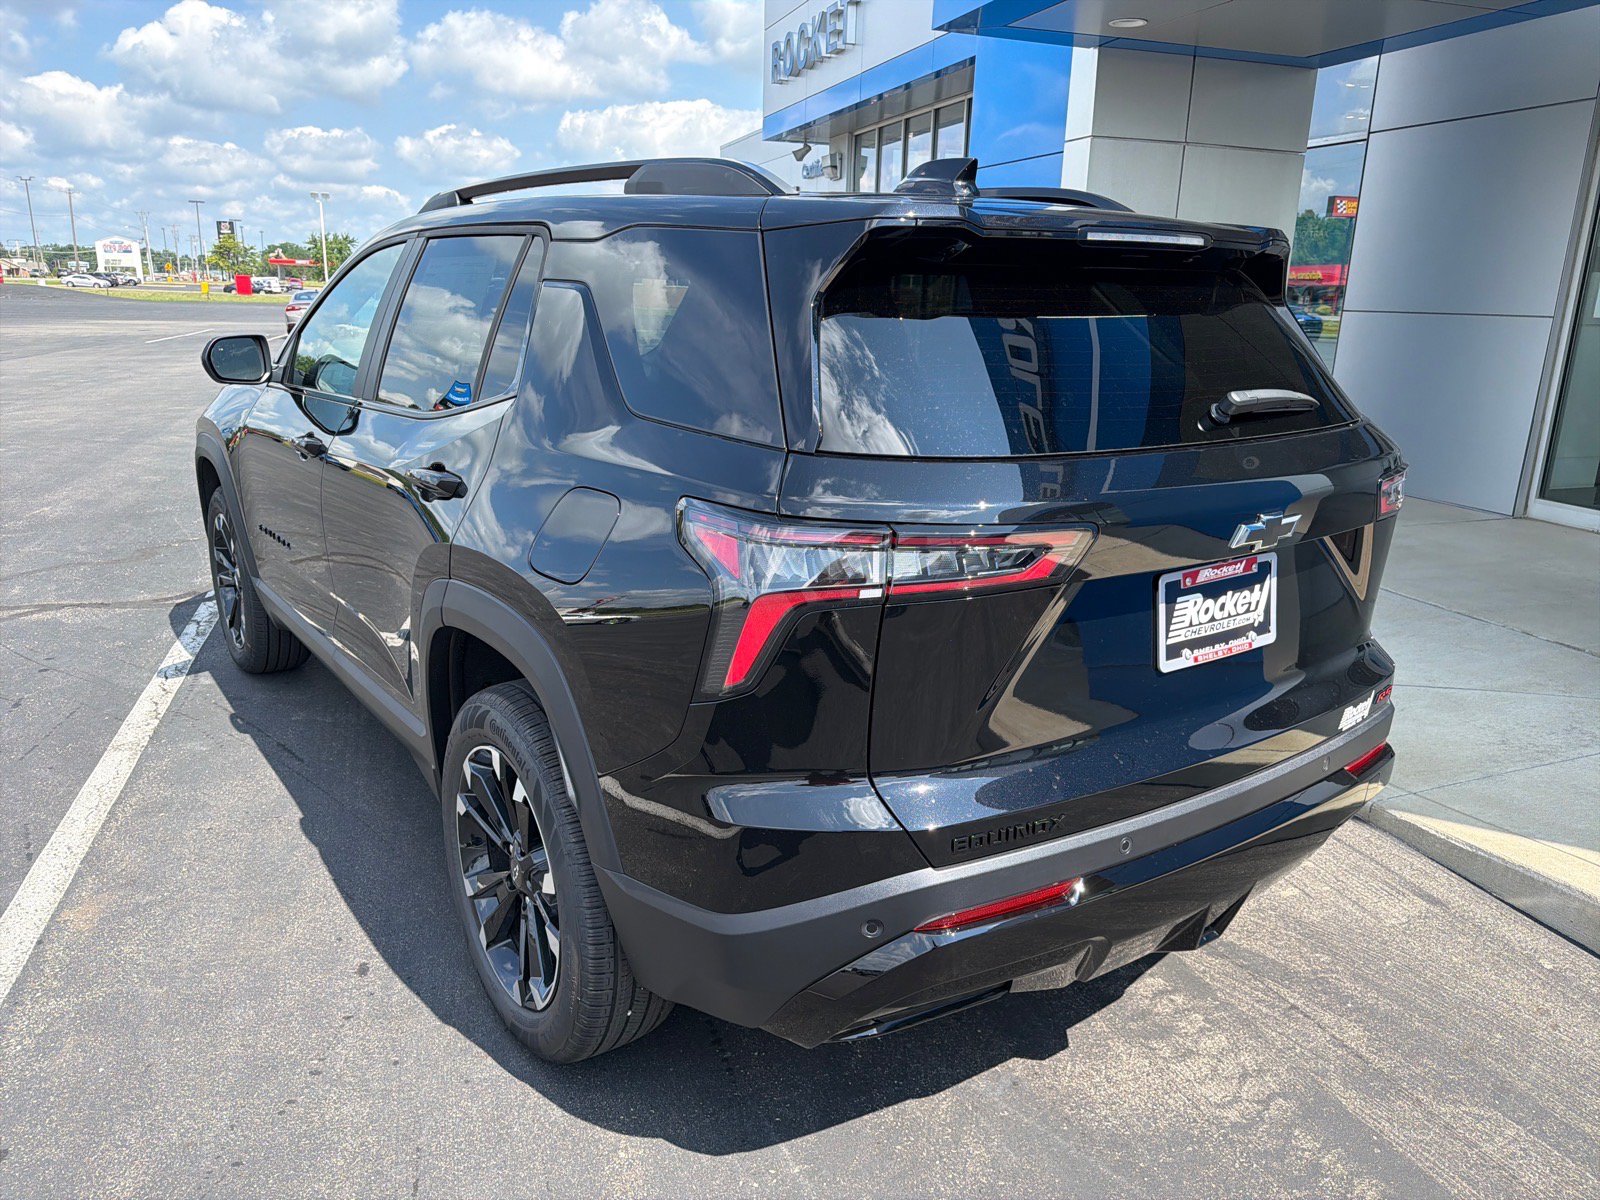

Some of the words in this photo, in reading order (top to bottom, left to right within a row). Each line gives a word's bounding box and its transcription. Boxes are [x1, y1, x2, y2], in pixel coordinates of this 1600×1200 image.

[770, 0, 862, 84] ROCKET
[1184, 616, 1252, 639] CHEVROLET.COM
[489, 718, 527, 771] Continental
[950, 813, 1066, 854] EQUINOX
